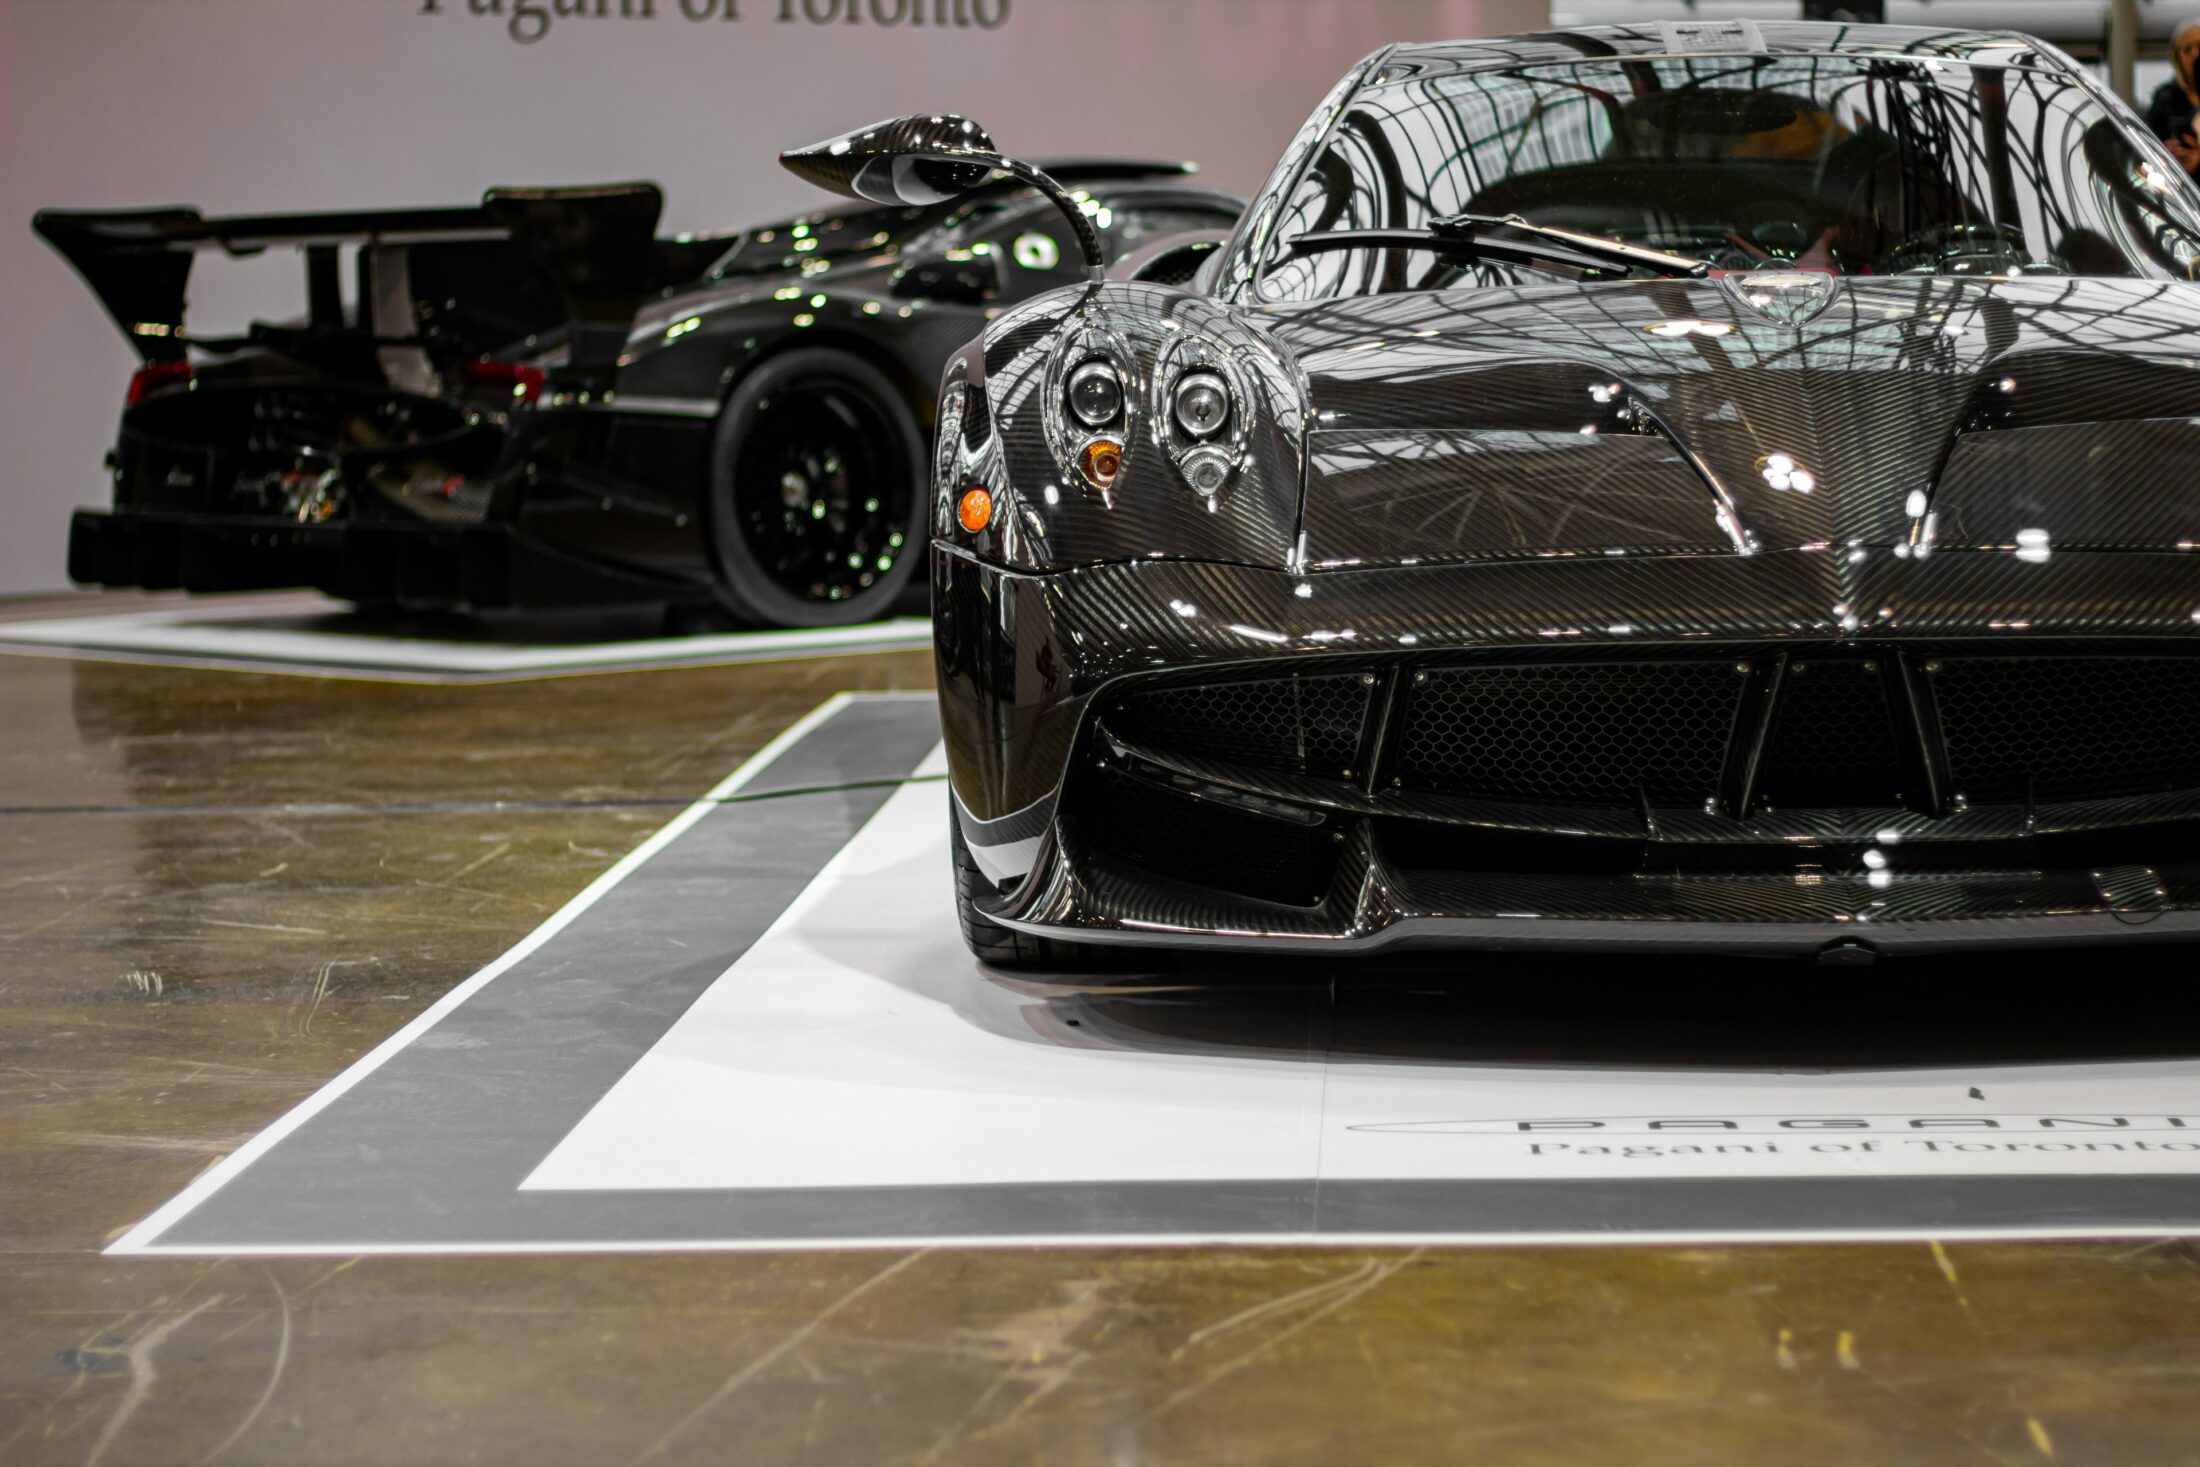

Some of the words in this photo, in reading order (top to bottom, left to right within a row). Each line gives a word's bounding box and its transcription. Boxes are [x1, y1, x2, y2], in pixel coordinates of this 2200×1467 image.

[1517, 1118, 2187, 1130] PAGANI
[1528, 1142, 1778, 1157] Pagani
[1810, 1140, 1881, 1152] of
[1903, 1140, 2200, 1152] Toronto
